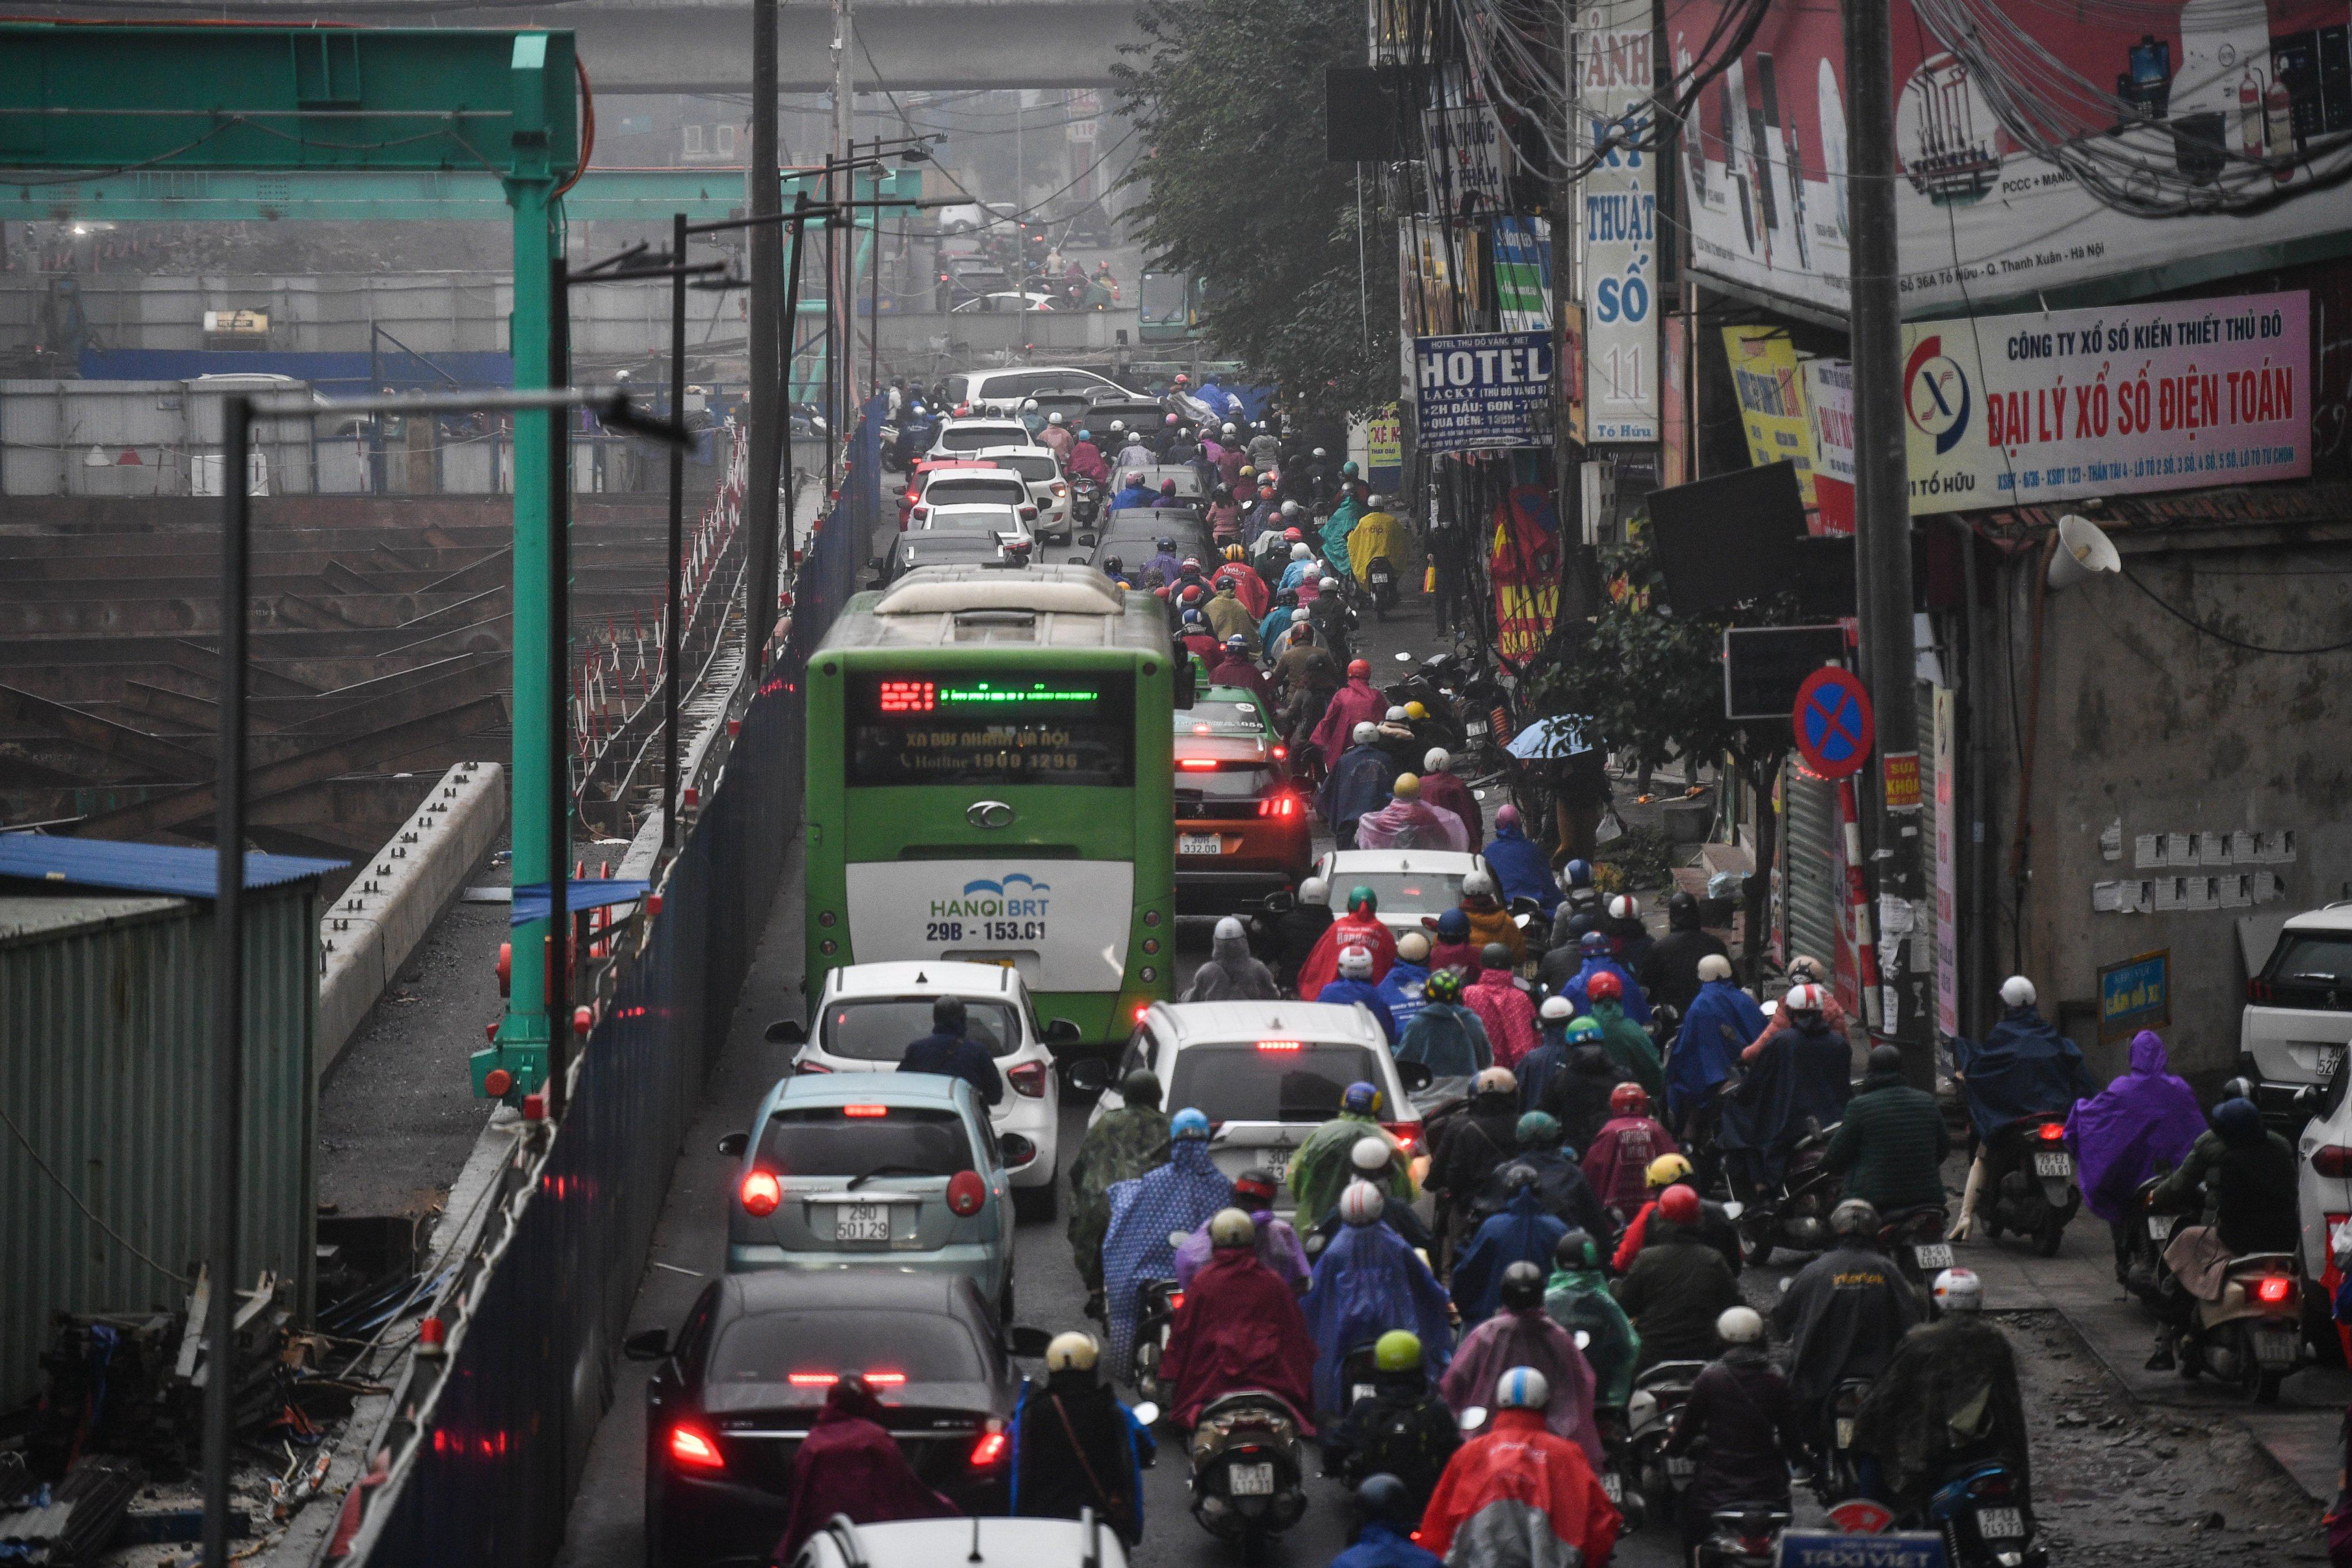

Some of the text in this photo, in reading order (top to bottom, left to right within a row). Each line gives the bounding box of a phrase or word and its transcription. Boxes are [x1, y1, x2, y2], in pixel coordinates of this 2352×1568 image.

[1586, 11, 1651, 87] ẢNH
[1592, 103, 1648, 168] KỸ
[2003, 178, 2032, 194] PCCC
[1587, 180, 1655, 251] THUẬT
[1901, 277, 1914, 292] Số
[1917, 274, 1937, 289] 36A
[1939, 268, 1953, 284] Tố
[1956, 269, 1978, 281] Hữu
[1987, 264, 1999, 276] Q.
[2001, 257, 2034, 273] Thanh
[2036, 252, 2063, 266] Xuân
[2071, 248, 2085, 260] Hà
[2087, 242, 2105, 258] Nội
[1597, 254, 1648, 323] SỐ
[2008, 308, 2282, 360] CÔNG TY XỔ SỐ KIẾN THIẾT THỦ ĐÔ
[1418, 347, 1551, 388] HOTEL
[1606, 346, 1647, 400] 11
[1424, 388, 1476, 400] LACKY
[1487, 400, 1513, 411] 60N
[1988, 357, 2293, 455] ĐẠI LÝ XỔ SỐ ĐIỆN TOÁN
[1431, 417, 1454, 430] QUA
[1597, 424, 1651, 437] Tố Hữu
[2157, 458, 2162, 476] 2
[1920, 470, 1940, 495] TỐ
[1944, 472, 1975, 493] HỮU
[916, 755, 970, 769] Hotline
[1184, 844, 1217, 853] 332.00
[930, 899, 1050, 918] HANOI BRT
[926, 922, 963, 941] 29B
[984, 921, 1045, 941] 153.01
[837, 1223, 887, 1239] 501.29
